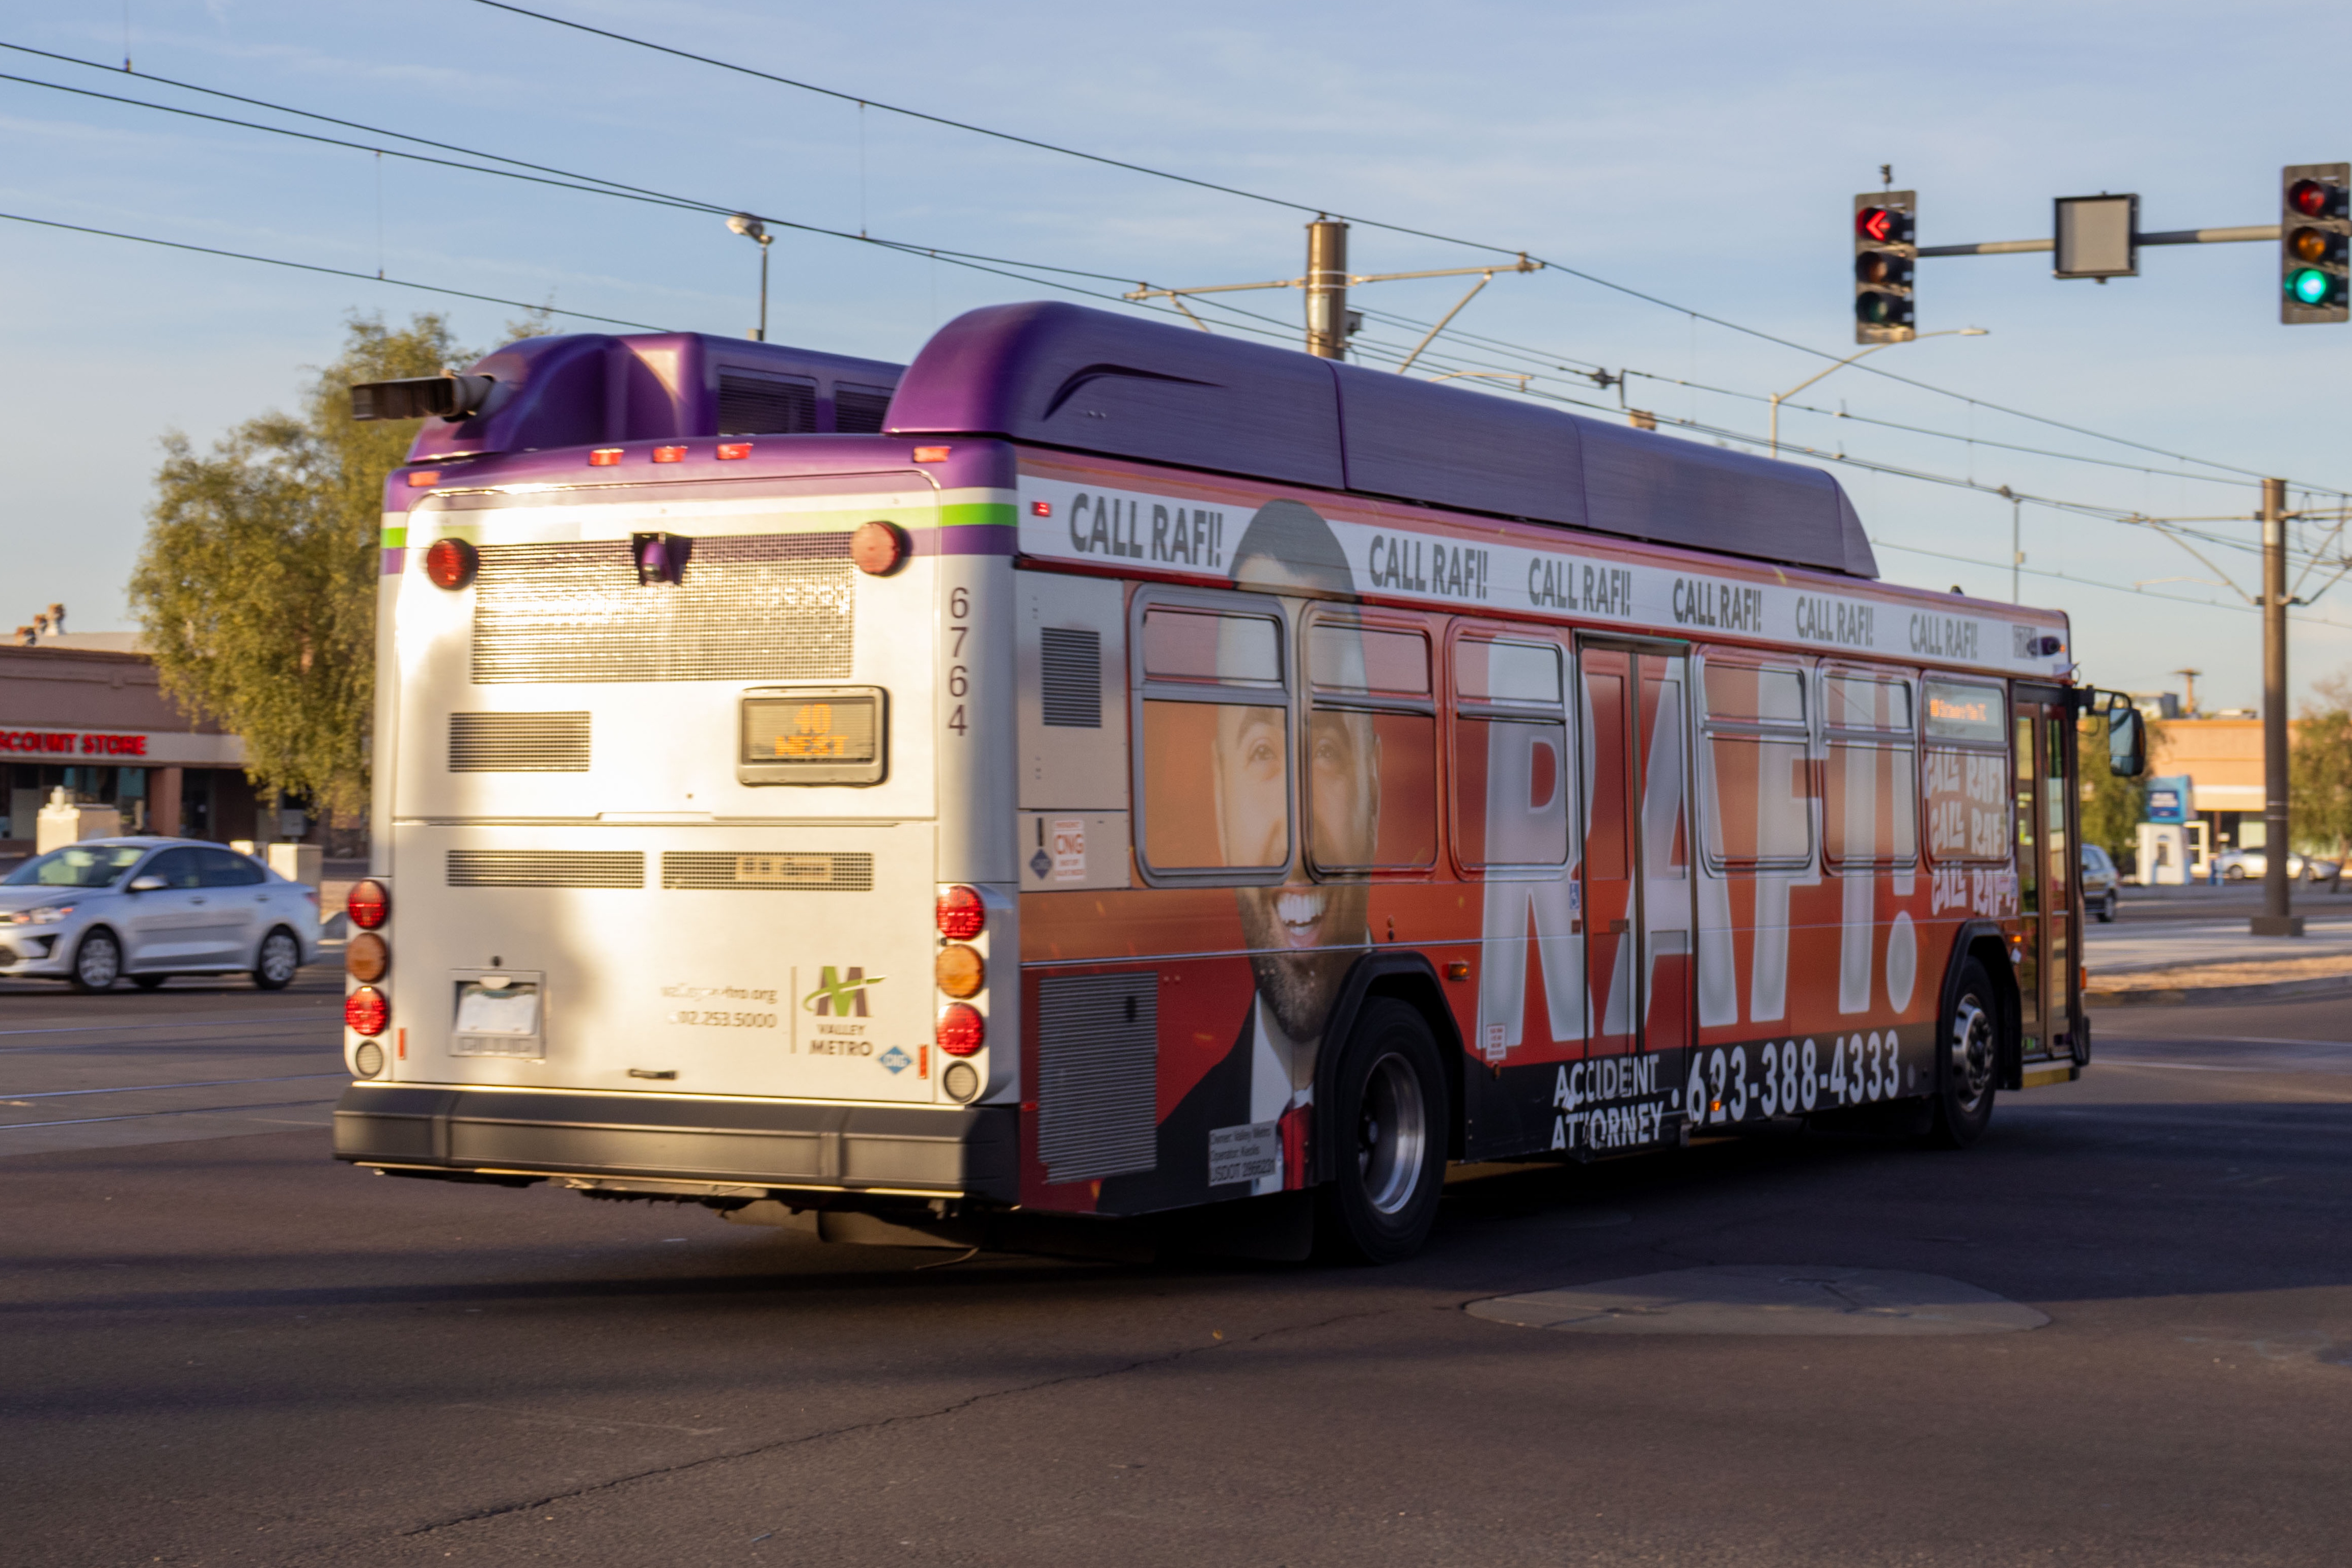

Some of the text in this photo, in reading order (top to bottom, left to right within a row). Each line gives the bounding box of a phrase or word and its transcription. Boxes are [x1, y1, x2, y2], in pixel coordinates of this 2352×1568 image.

[1070, 493, 1223, 568] CALL RAFI!
[1370, 535, 1488, 599] CALL RAFI!
[1529, 557, 1631, 616] CALL RAFI!
[1673, 578, 1761, 632] CALL RAFI!
[1796, 597, 1873, 646] CALL RAFI!
[948, 587, 969, 736] 6764
[1911, 614, 1977, 659] CALL RAFI!
[83, 734, 147, 755] STORE
[794, 704, 832, 734] 40
[1476, 640, 1918, 1051] RAFI!
[809, 1040, 873, 1056] METRO
[816, 1024, 866, 1035] VALLEY
[1553, 1053, 1659, 1107] ACCIDENT
[1686, 1029, 1899, 1126] 623-388-4333
[1551, 1101, 1665, 1150] ATTORNEY
